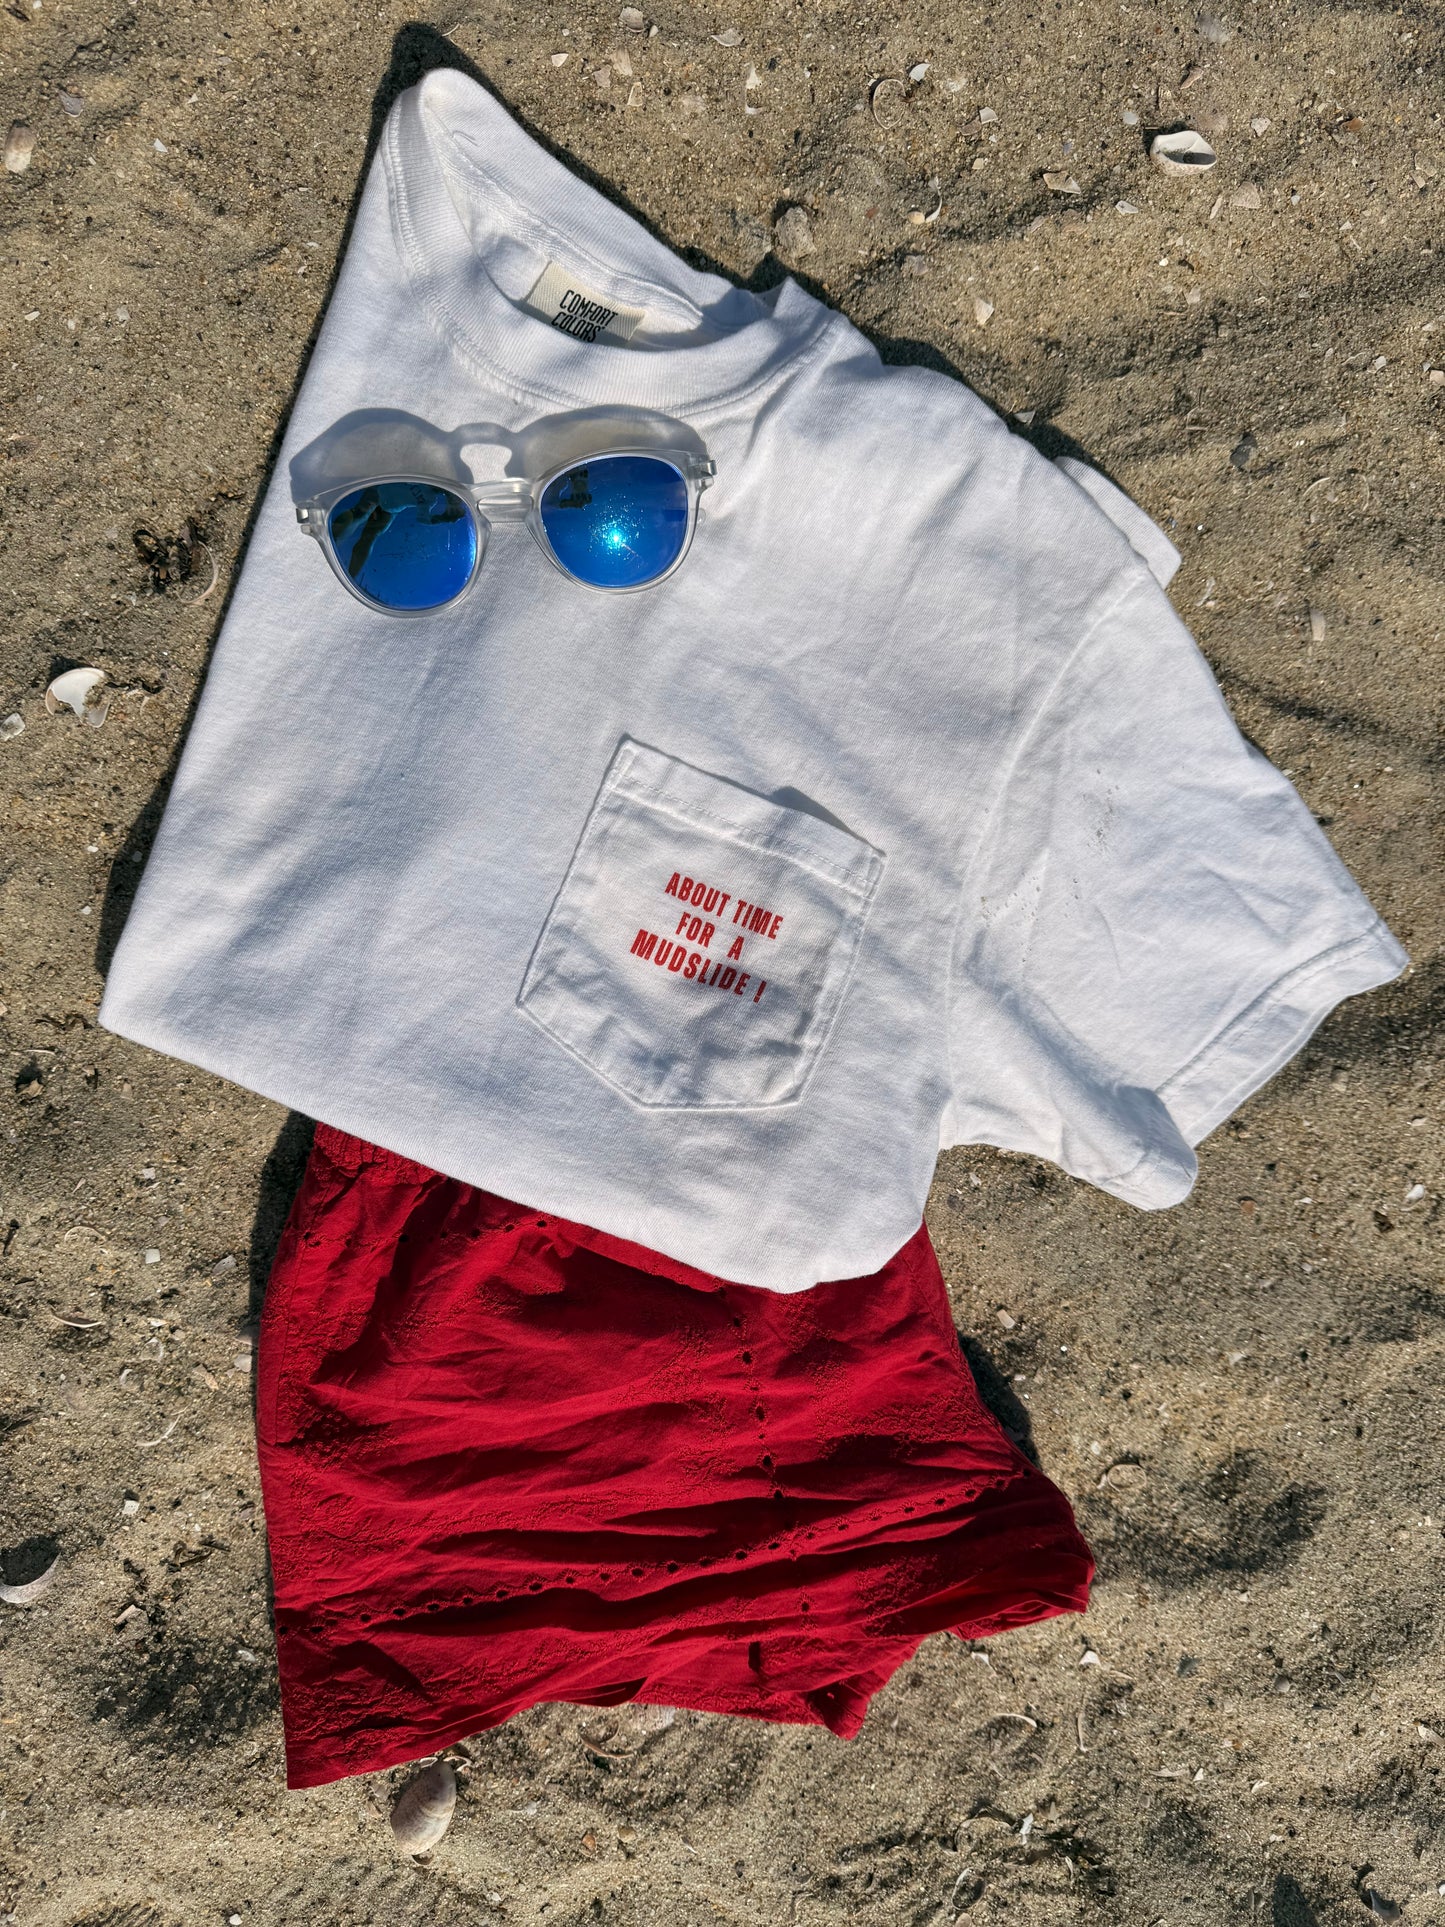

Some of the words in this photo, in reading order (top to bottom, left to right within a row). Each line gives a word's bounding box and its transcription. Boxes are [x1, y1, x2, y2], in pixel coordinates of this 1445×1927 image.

[551, 311, 603, 343] COLORS
[559, 289, 618, 327] COMFORT
[664, 872, 731, 917] ABOUT
[732, 899, 784, 940] TIME
[675, 911, 715, 948] FOR
[727, 935, 745, 961] A
[630, 928, 752, 996] MUDSLIDE
